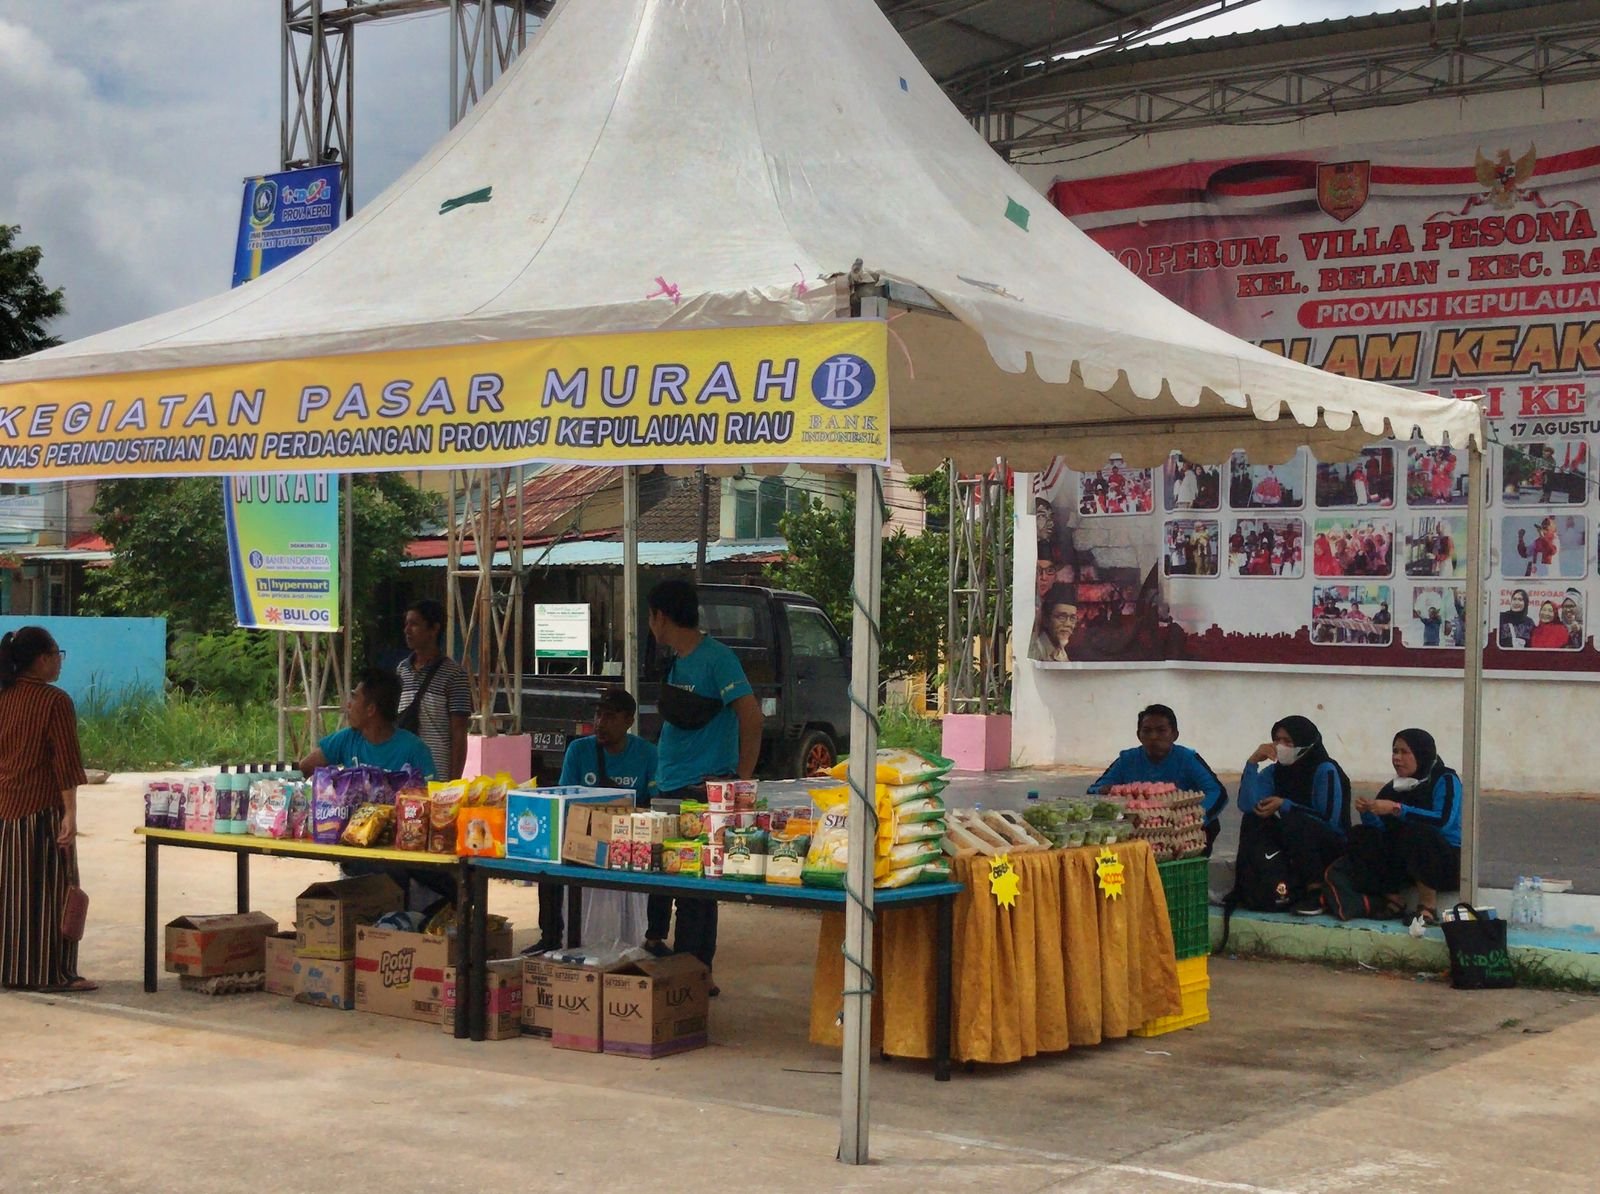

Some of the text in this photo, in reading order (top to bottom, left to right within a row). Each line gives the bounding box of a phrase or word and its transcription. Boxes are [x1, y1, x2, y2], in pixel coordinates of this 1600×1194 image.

[1148, 235, 1288, 275] PERUM.
[1299, 225, 1414, 259] VILLA
[1422, 209, 1597, 251] PESONA
[1237, 271, 1309, 297] KEL.
[1319, 259, 1440, 291] BELIAN
[1468, 251, 1552, 281] KEC.
[1317, 287, 1600, 323] PROVINSI KEPULAUA
[0, 358, 799, 438] KEGIATAN PASAR MURAH
[1519, 384, 1584, 416] KE
[810, 415, 880, 431] BANK
[1510, 420, 1600, 436] 17 AGUSTU
[0, 410, 795, 469] NAS PERINDUSTRIAN DAN PERDAGANGAN PROVINSI KEPULAUAN RIAU
[801, 430, 882, 445] INDONESIA
[236, 474, 329, 502] MURAH
[271, 580, 328, 591] hypermart
[283, 608, 329, 621] BULOG
[609, 776, 638, 788] pay
[380, 950, 414, 974] Pota
[384, 966, 412, 988] bee
[558, 994, 590, 1012] LUX
[666, 986, 694, 1007] LUX
[608, 1001, 642, 1018] LUX
